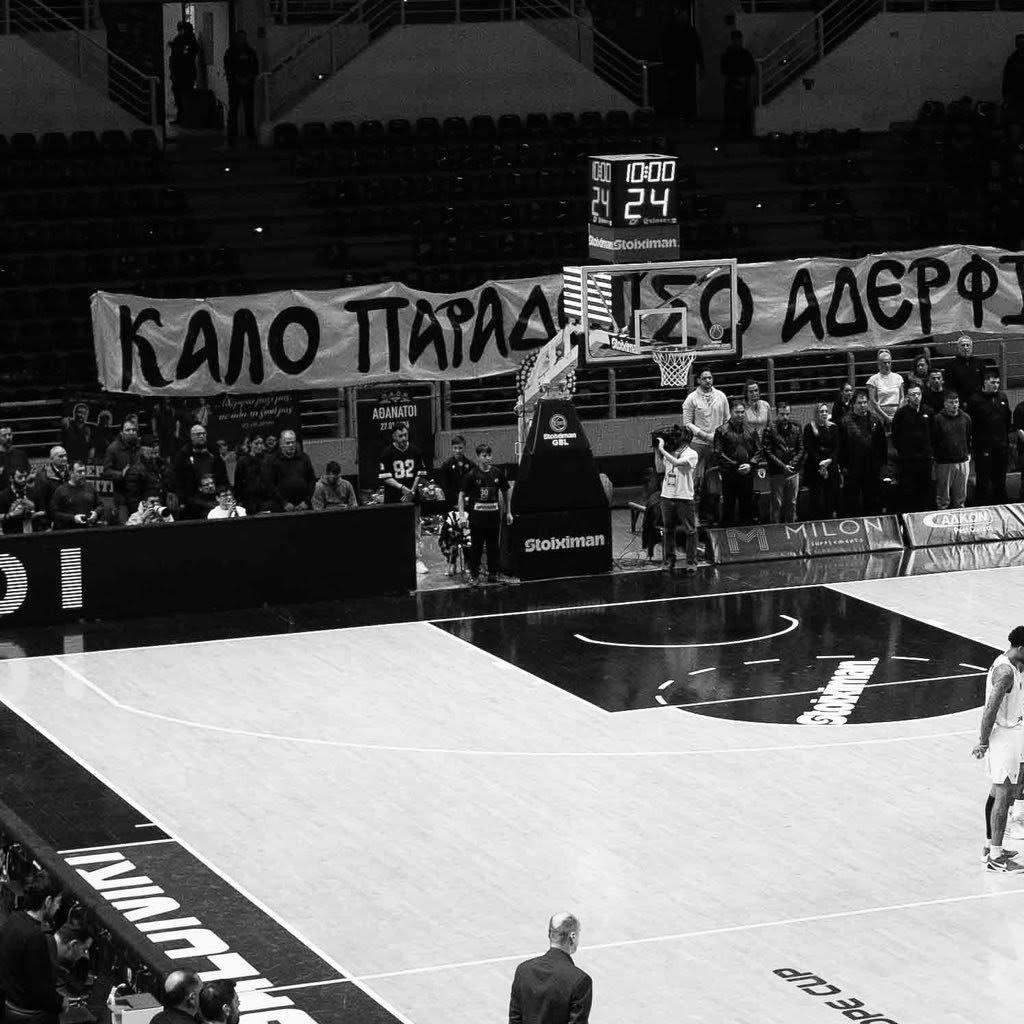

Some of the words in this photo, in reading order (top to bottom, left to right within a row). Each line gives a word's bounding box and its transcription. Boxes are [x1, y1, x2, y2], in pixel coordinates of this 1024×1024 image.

[625, 160, 676, 184] 10:00
[591, 186, 610, 218] 24
[624, 187, 670, 219] 24
[613, 238, 678, 251] Stoiximan
[119, 305, 320, 391] ΚΑΛΟ
[784, 516, 884, 540] MILON
[524, 534, 605, 553] Stoiximan
[796, 656, 881, 726] Stoiximan
[772, 968, 842, 996] CUP
